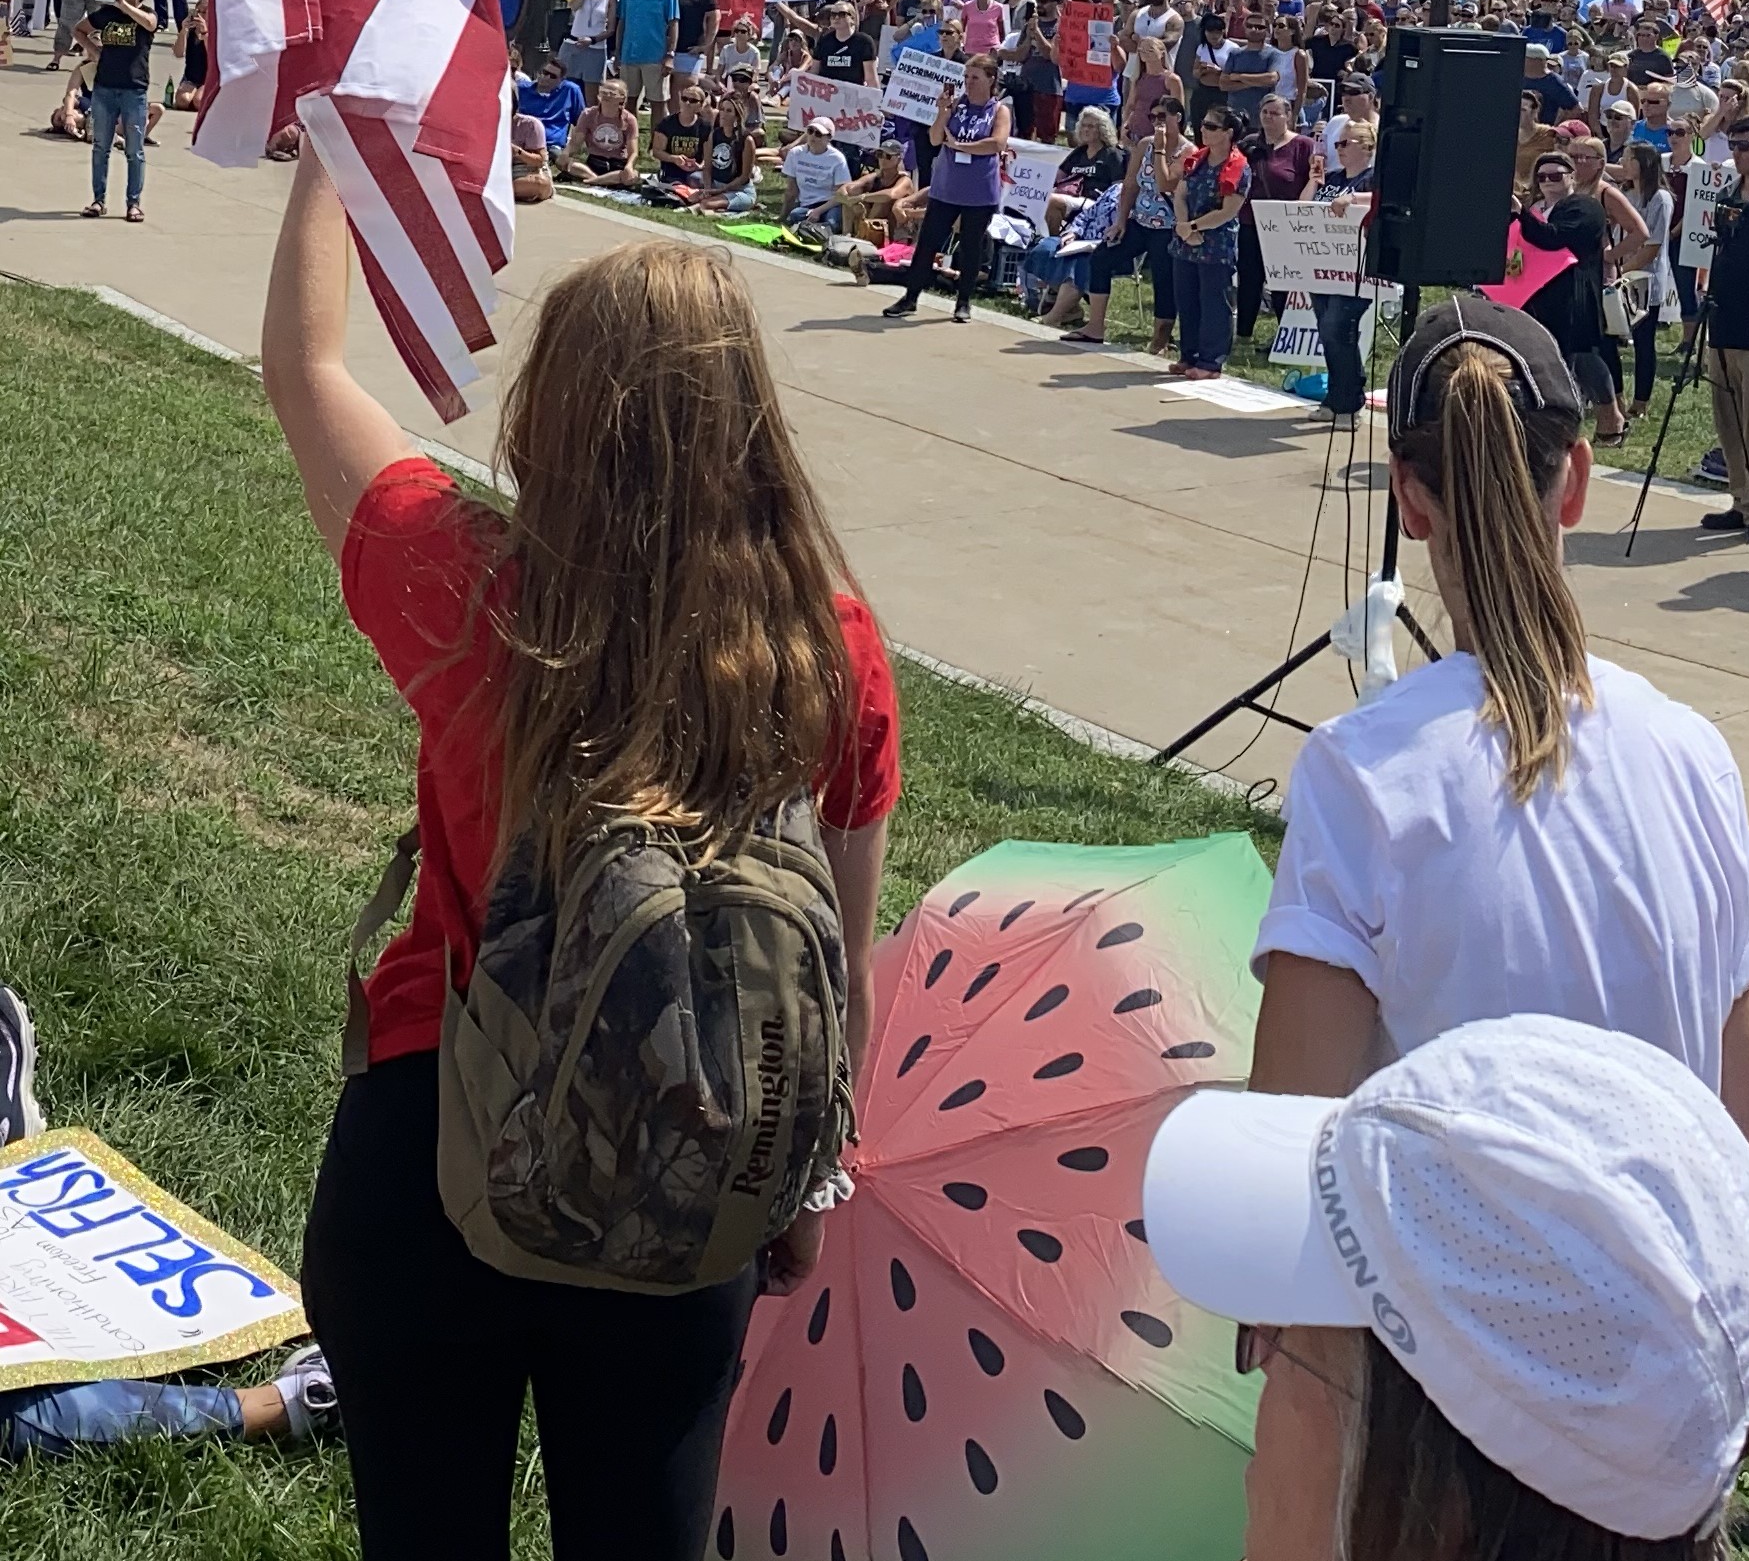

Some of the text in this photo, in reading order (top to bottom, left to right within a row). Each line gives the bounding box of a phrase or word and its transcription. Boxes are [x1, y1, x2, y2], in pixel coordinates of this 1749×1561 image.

[796, 75, 840, 104] STOP
[898, 87, 938, 106] IMMUNIT
[1284, 203, 1315, 217] LAST
[1260, 220, 1280, 233] We
[1289, 220, 1316, 234] Were
[1294, 241, 1331, 256] THIS
[0, 1151, 276, 1319] SELFISH
